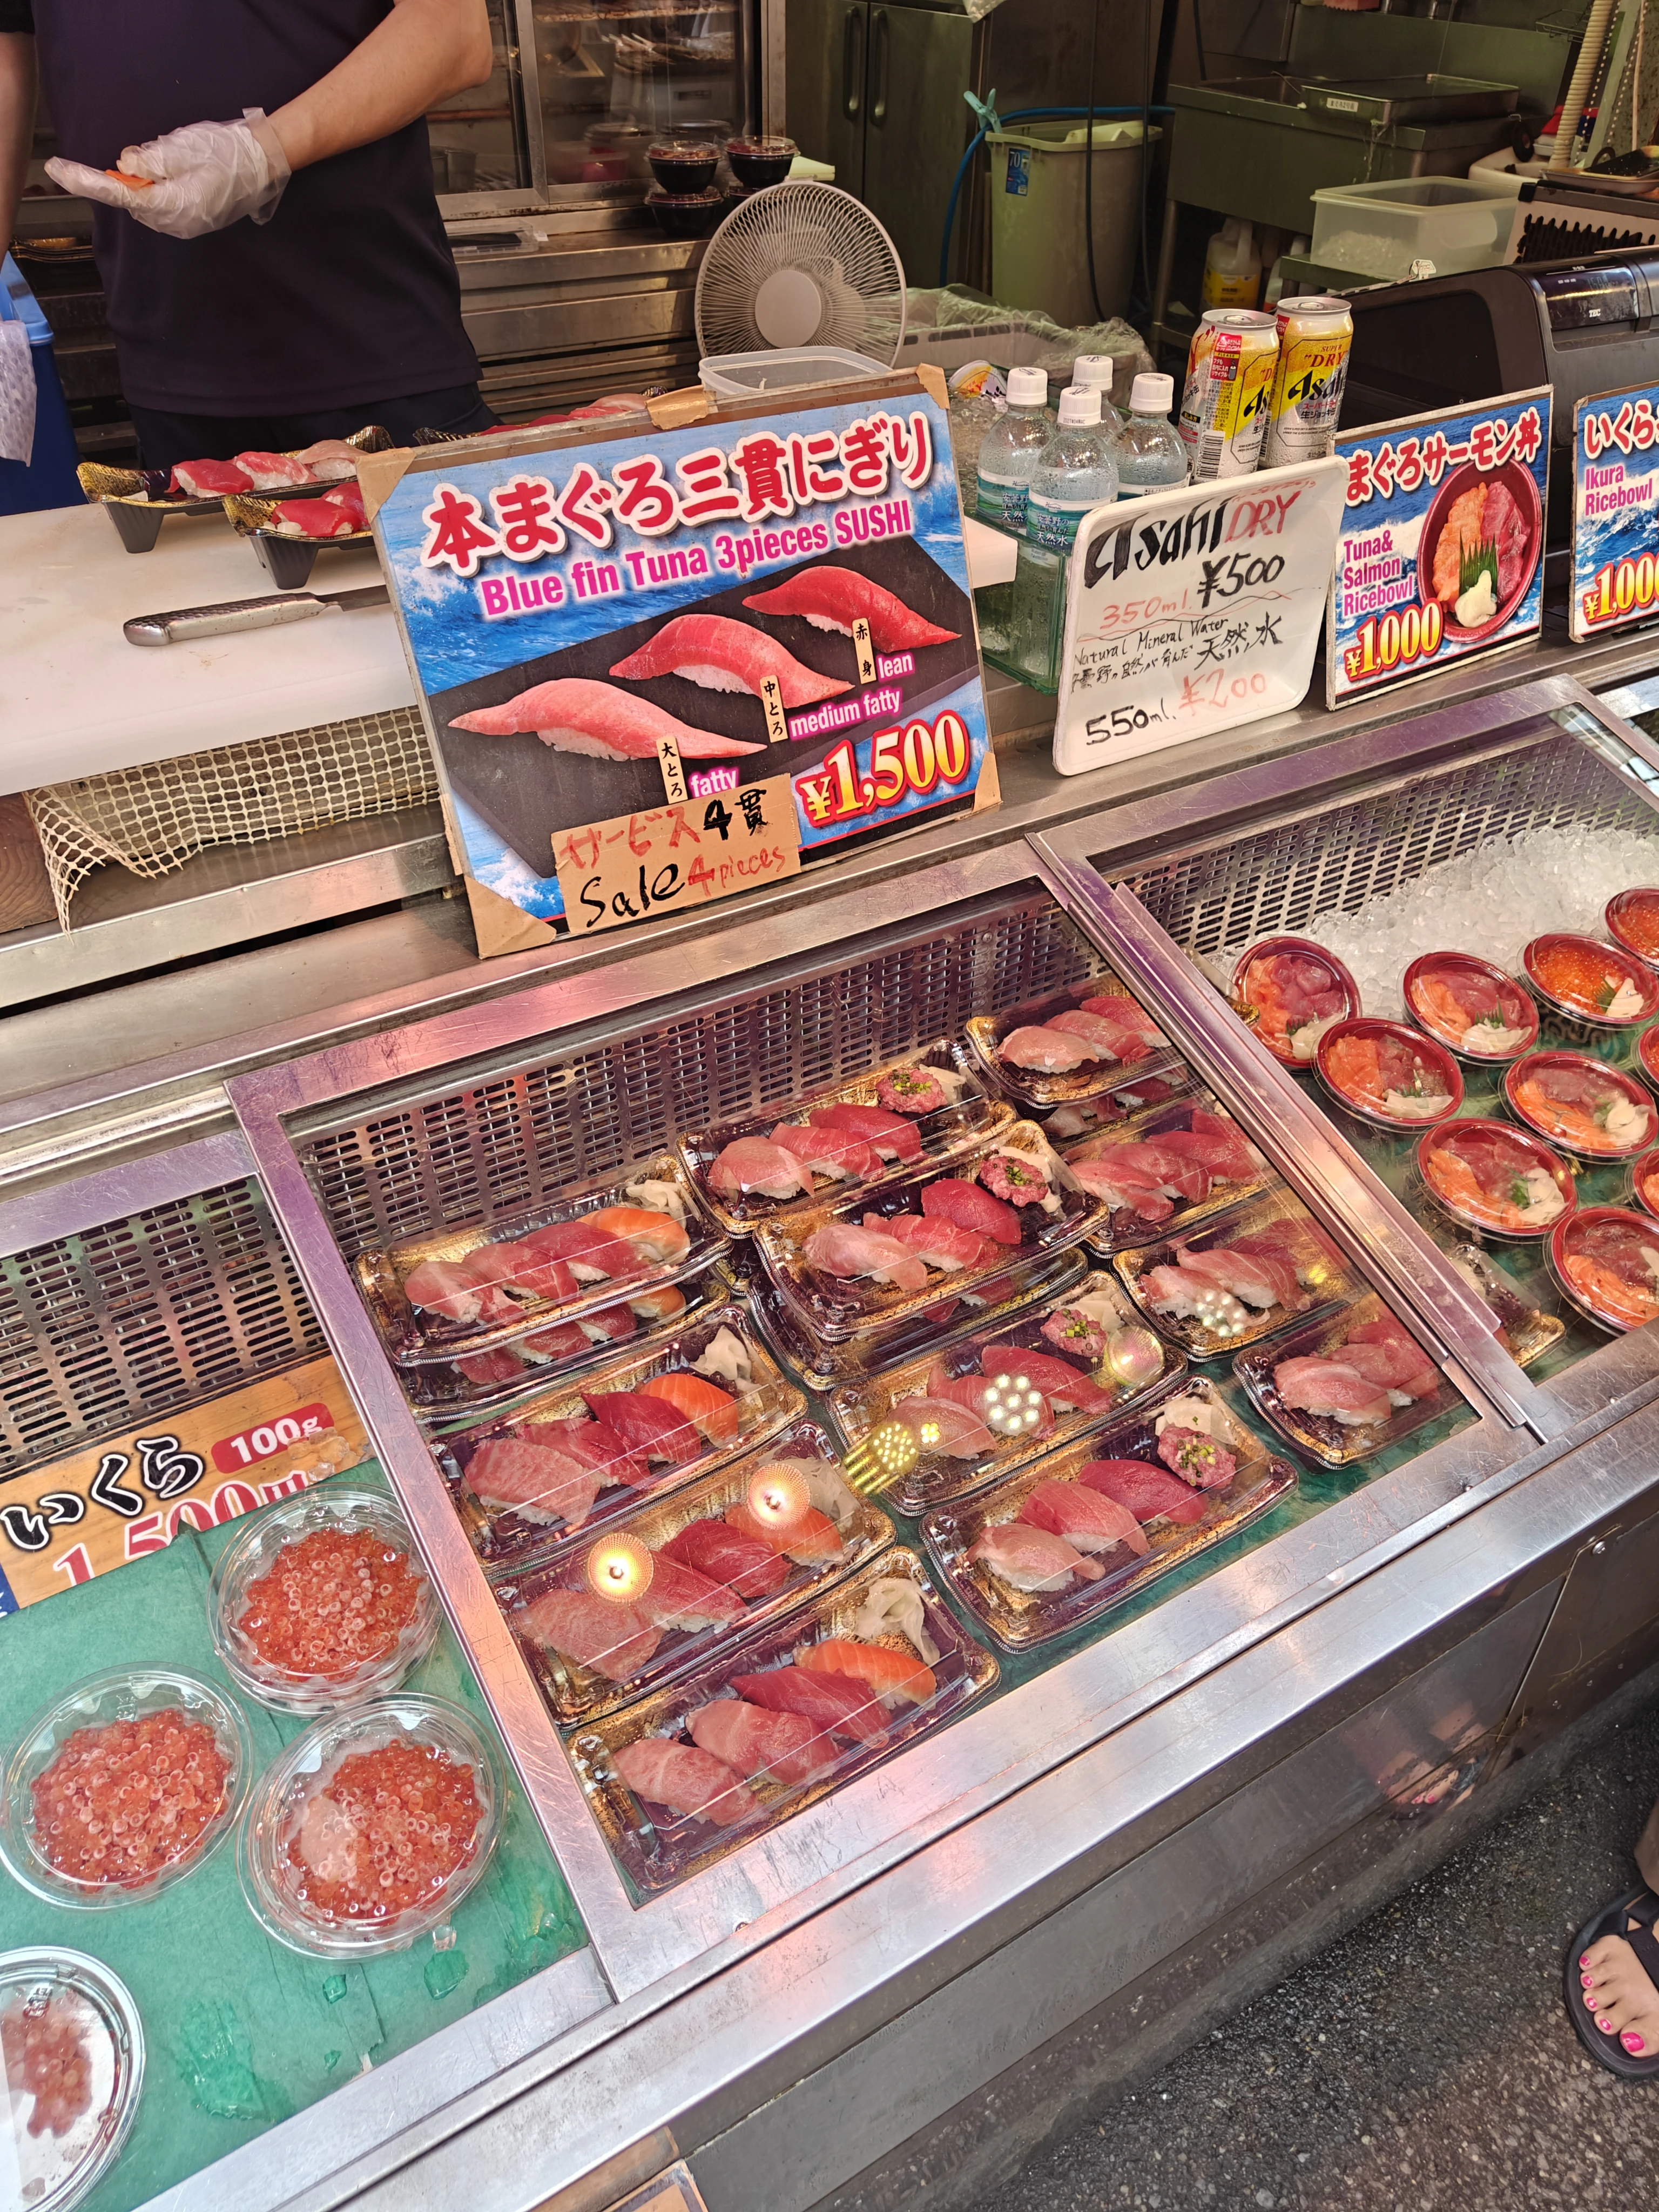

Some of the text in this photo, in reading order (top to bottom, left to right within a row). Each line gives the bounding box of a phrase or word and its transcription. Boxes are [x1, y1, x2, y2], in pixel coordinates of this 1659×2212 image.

[1589, 308, 1601, 318] TEC
[1321, 345, 1342, 353] SUPER
[1585, 401, 1659, 458] いくら
[1346, 408, 1542, 502] まぐろサーモン丼
[1586, 466, 1623, 490] Ikura
[424, 413, 931, 572] 本まぐろ三貫にぎり
[1224, 490, 1301, 543] DRY
[1585, 478, 1653, 516] Ricebowl
[481, 499, 913, 616] Blue fin Tuna 3pieces SUSHI
[1036, 531, 1069, 547] 天然水
[1344, 529, 1393, 563] Tuna&
[1197, 552, 1285, 609] ¥500
[1344, 558, 1400, 590] Salmon
[1344, 579, 1413, 616] Ricebowl
[1584, 549, 1659, 620] ¥1,00
[855, 623, 872, 678] 赤身
[1075, 617, 1229, 666] Natural Mineral Water
[1346, 602, 1441, 677] ¥1,000
[878, 654, 913, 679] lean
[763, 680, 783, 736] 中とろ
[790, 689, 901, 738] medium fatty
[1179, 667, 1267, 717] ¥200
[662, 743, 683, 797] 大とろ
[690, 767, 739, 798] fatty
[801, 712, 968, 822] ¥1,500
[581, 863, 685, 928] Sale
[231, 1415, 323, 1464] 100g
